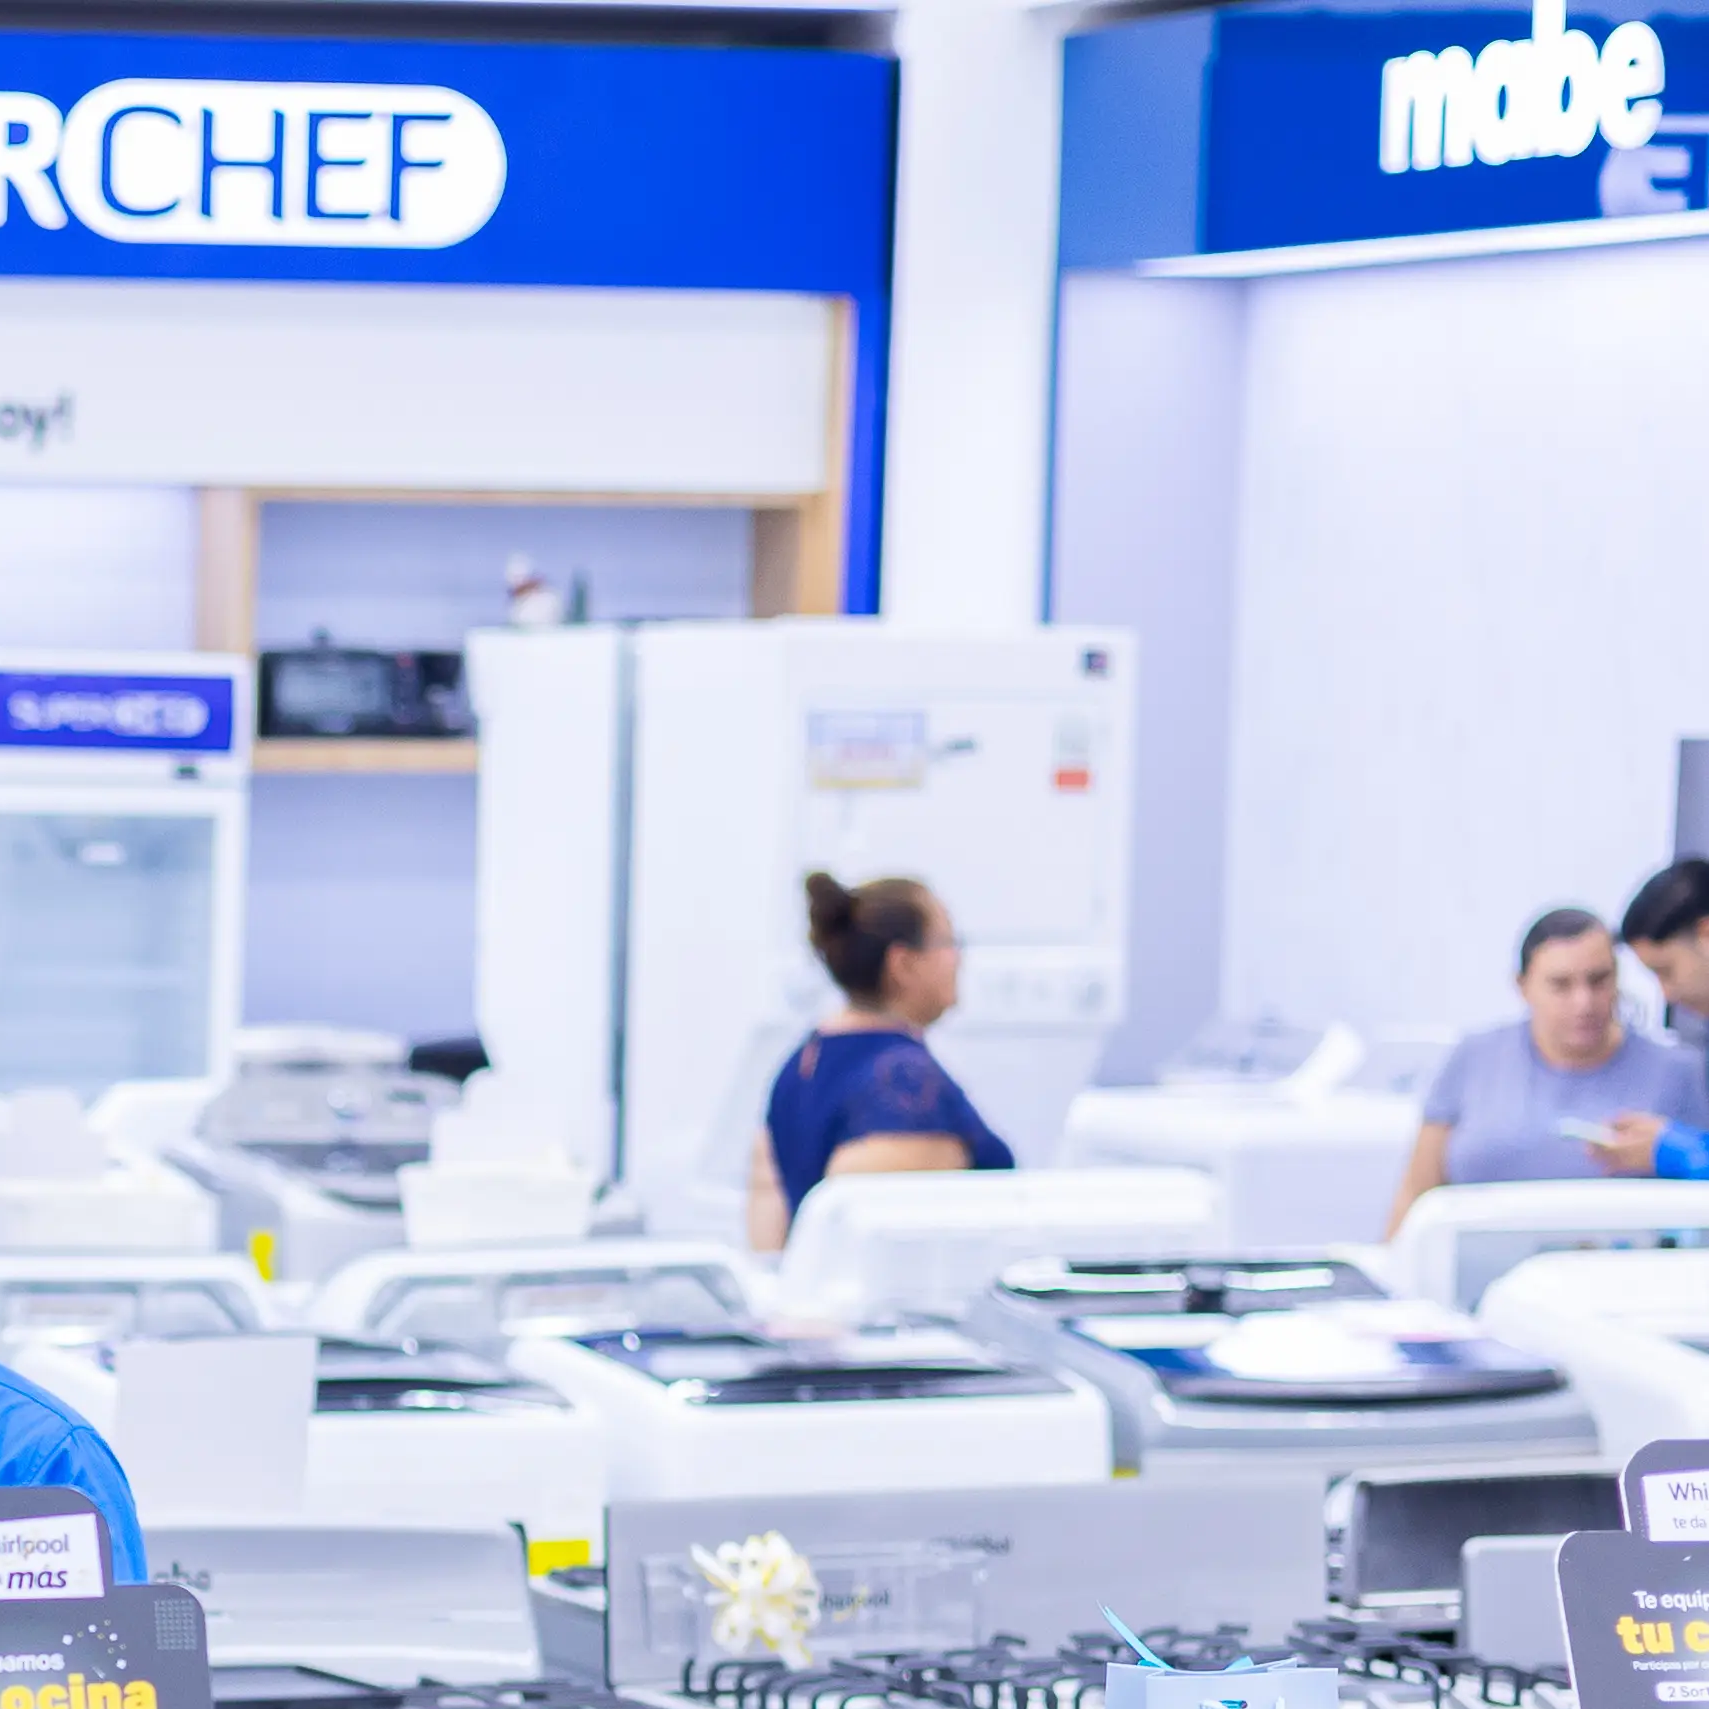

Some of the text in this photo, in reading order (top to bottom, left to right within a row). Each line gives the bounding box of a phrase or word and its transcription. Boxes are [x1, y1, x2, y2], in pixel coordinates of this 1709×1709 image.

[1379, 0, 1665, 173] mabe
[7, 1567, 68, 1590] más
[1632, 1590, 1657, 1609] Te
[1616, 1615, 1675, 1655] tu
[1667, 1686, 1675, 1699] 2
